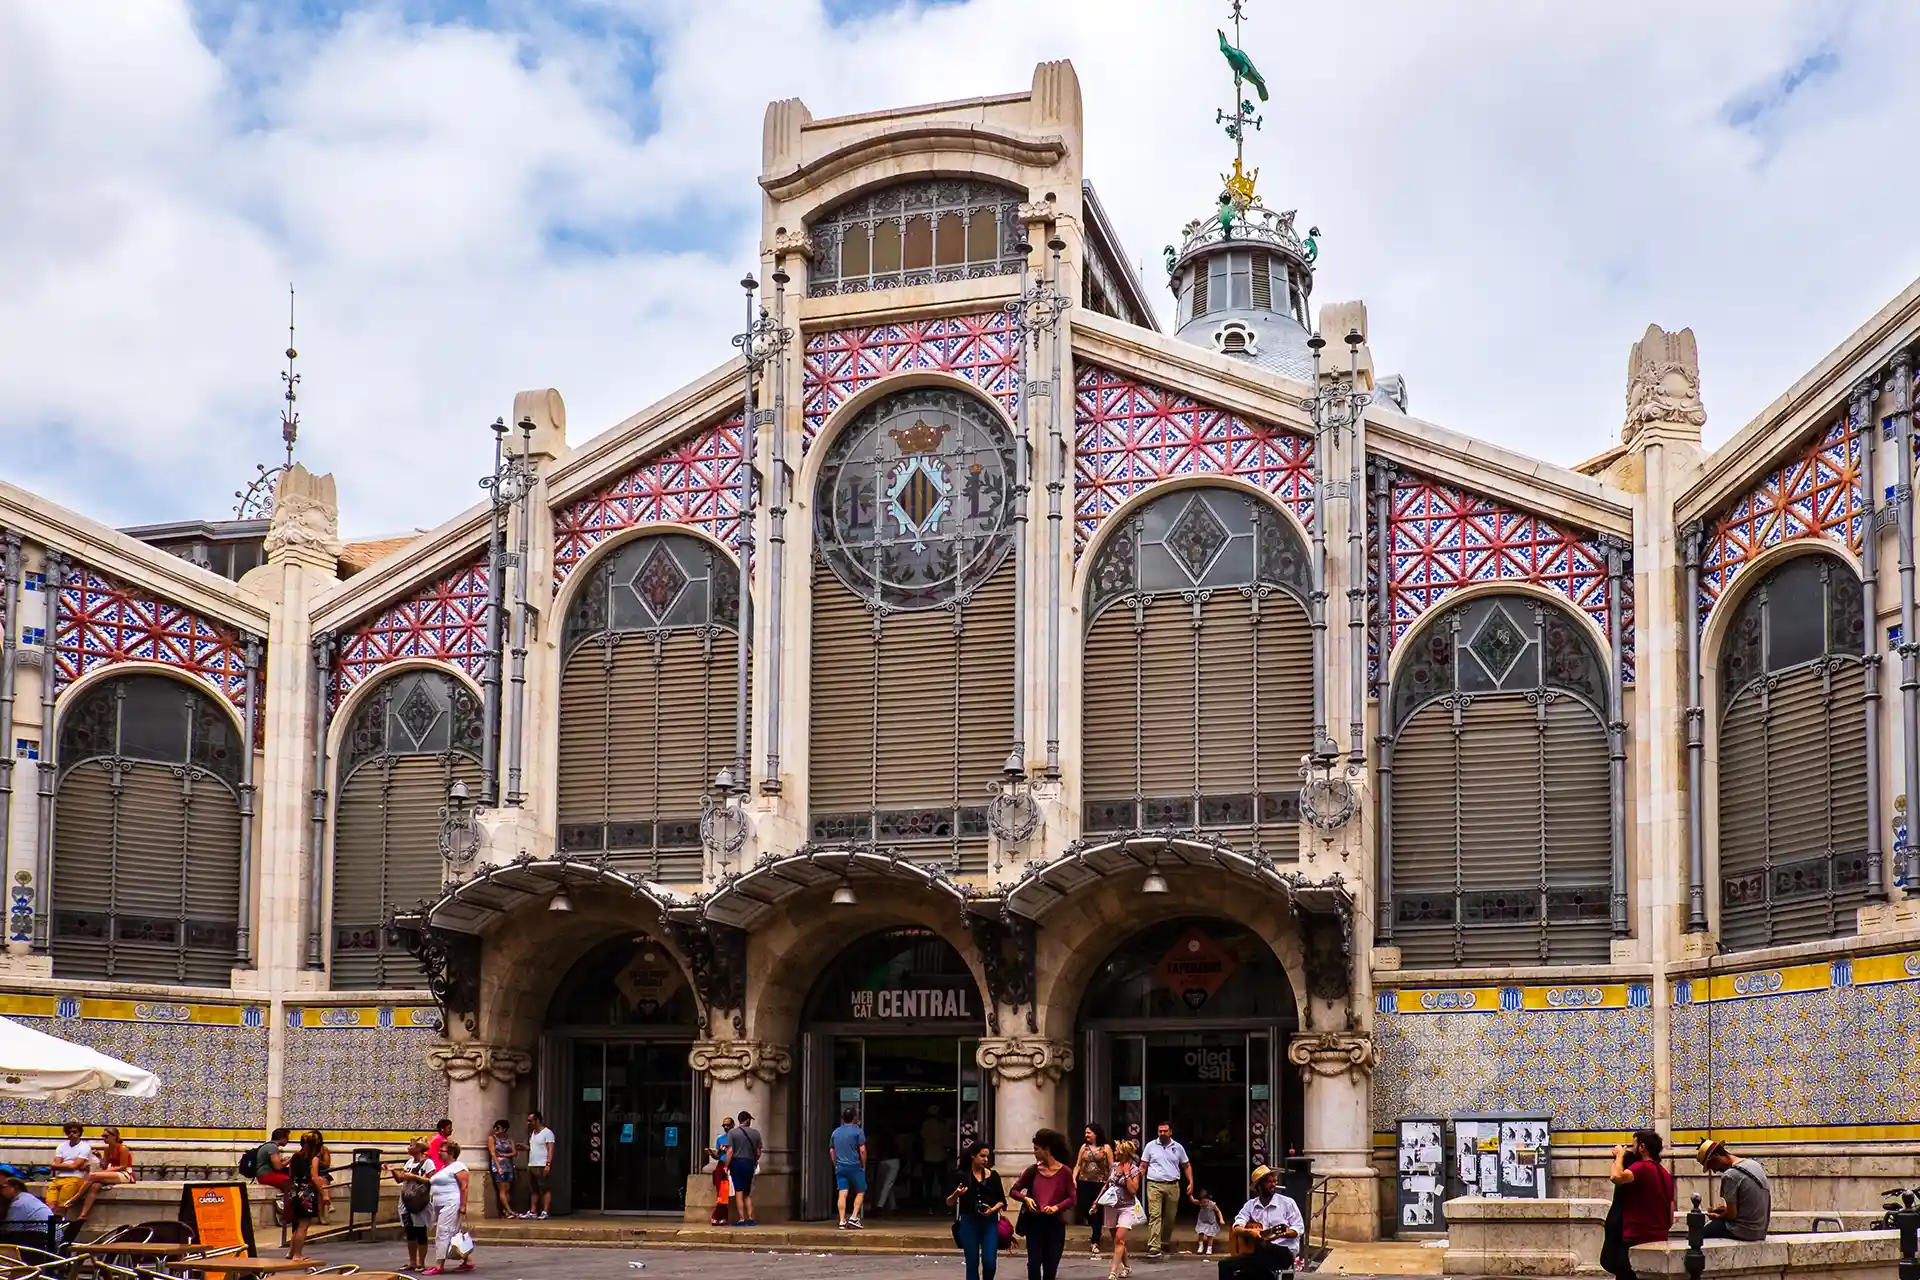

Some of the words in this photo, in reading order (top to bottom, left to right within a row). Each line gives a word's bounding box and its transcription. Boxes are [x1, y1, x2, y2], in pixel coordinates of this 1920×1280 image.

[851, 990, 873, 1004] MER
[878, 989, 971, 1017] CENTRAL
[854, 1004, 873, 1018] CAT
[1184, 1047, 1231, 1067] oiled
[1197, 1060, 1238, 1083] salt
[198, 1196, 225, 1205] CANDELAS
